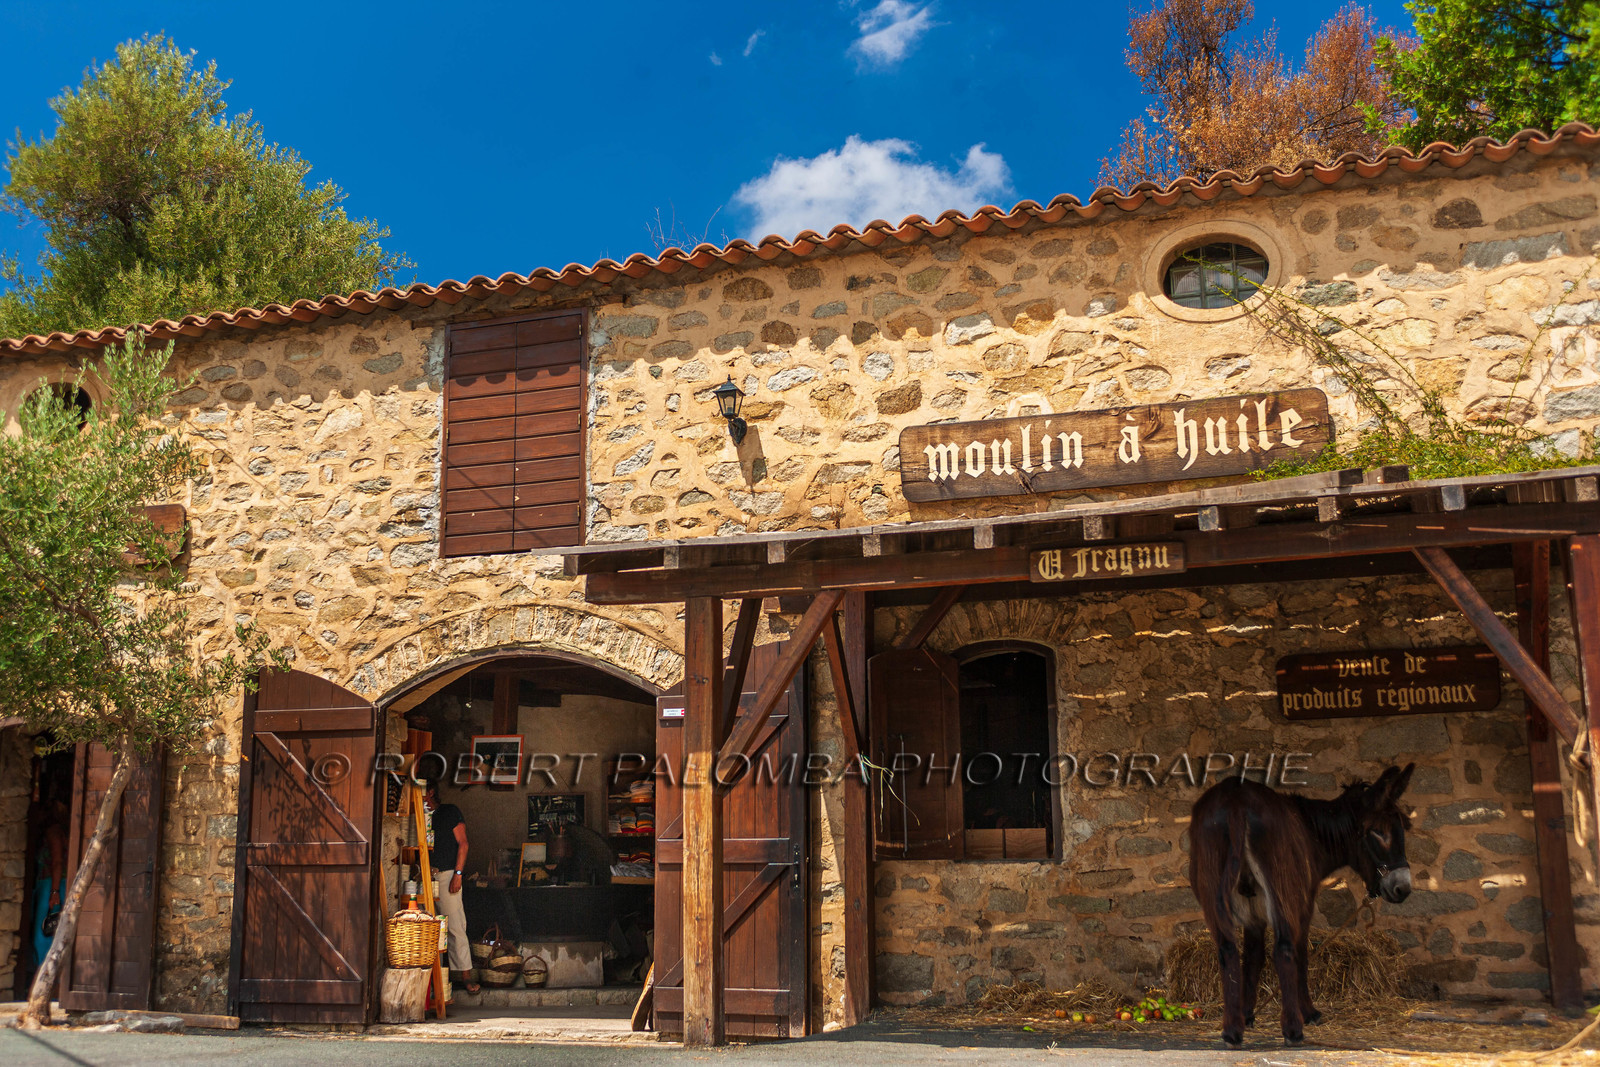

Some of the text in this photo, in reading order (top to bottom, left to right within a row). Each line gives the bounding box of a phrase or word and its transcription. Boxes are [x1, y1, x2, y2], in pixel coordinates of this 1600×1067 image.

[923, 398, 1305, 482] moulin à huile
[1335, 651, 1427, 678] vente de
[1282, 681, 1477, 716] produits régionaux
